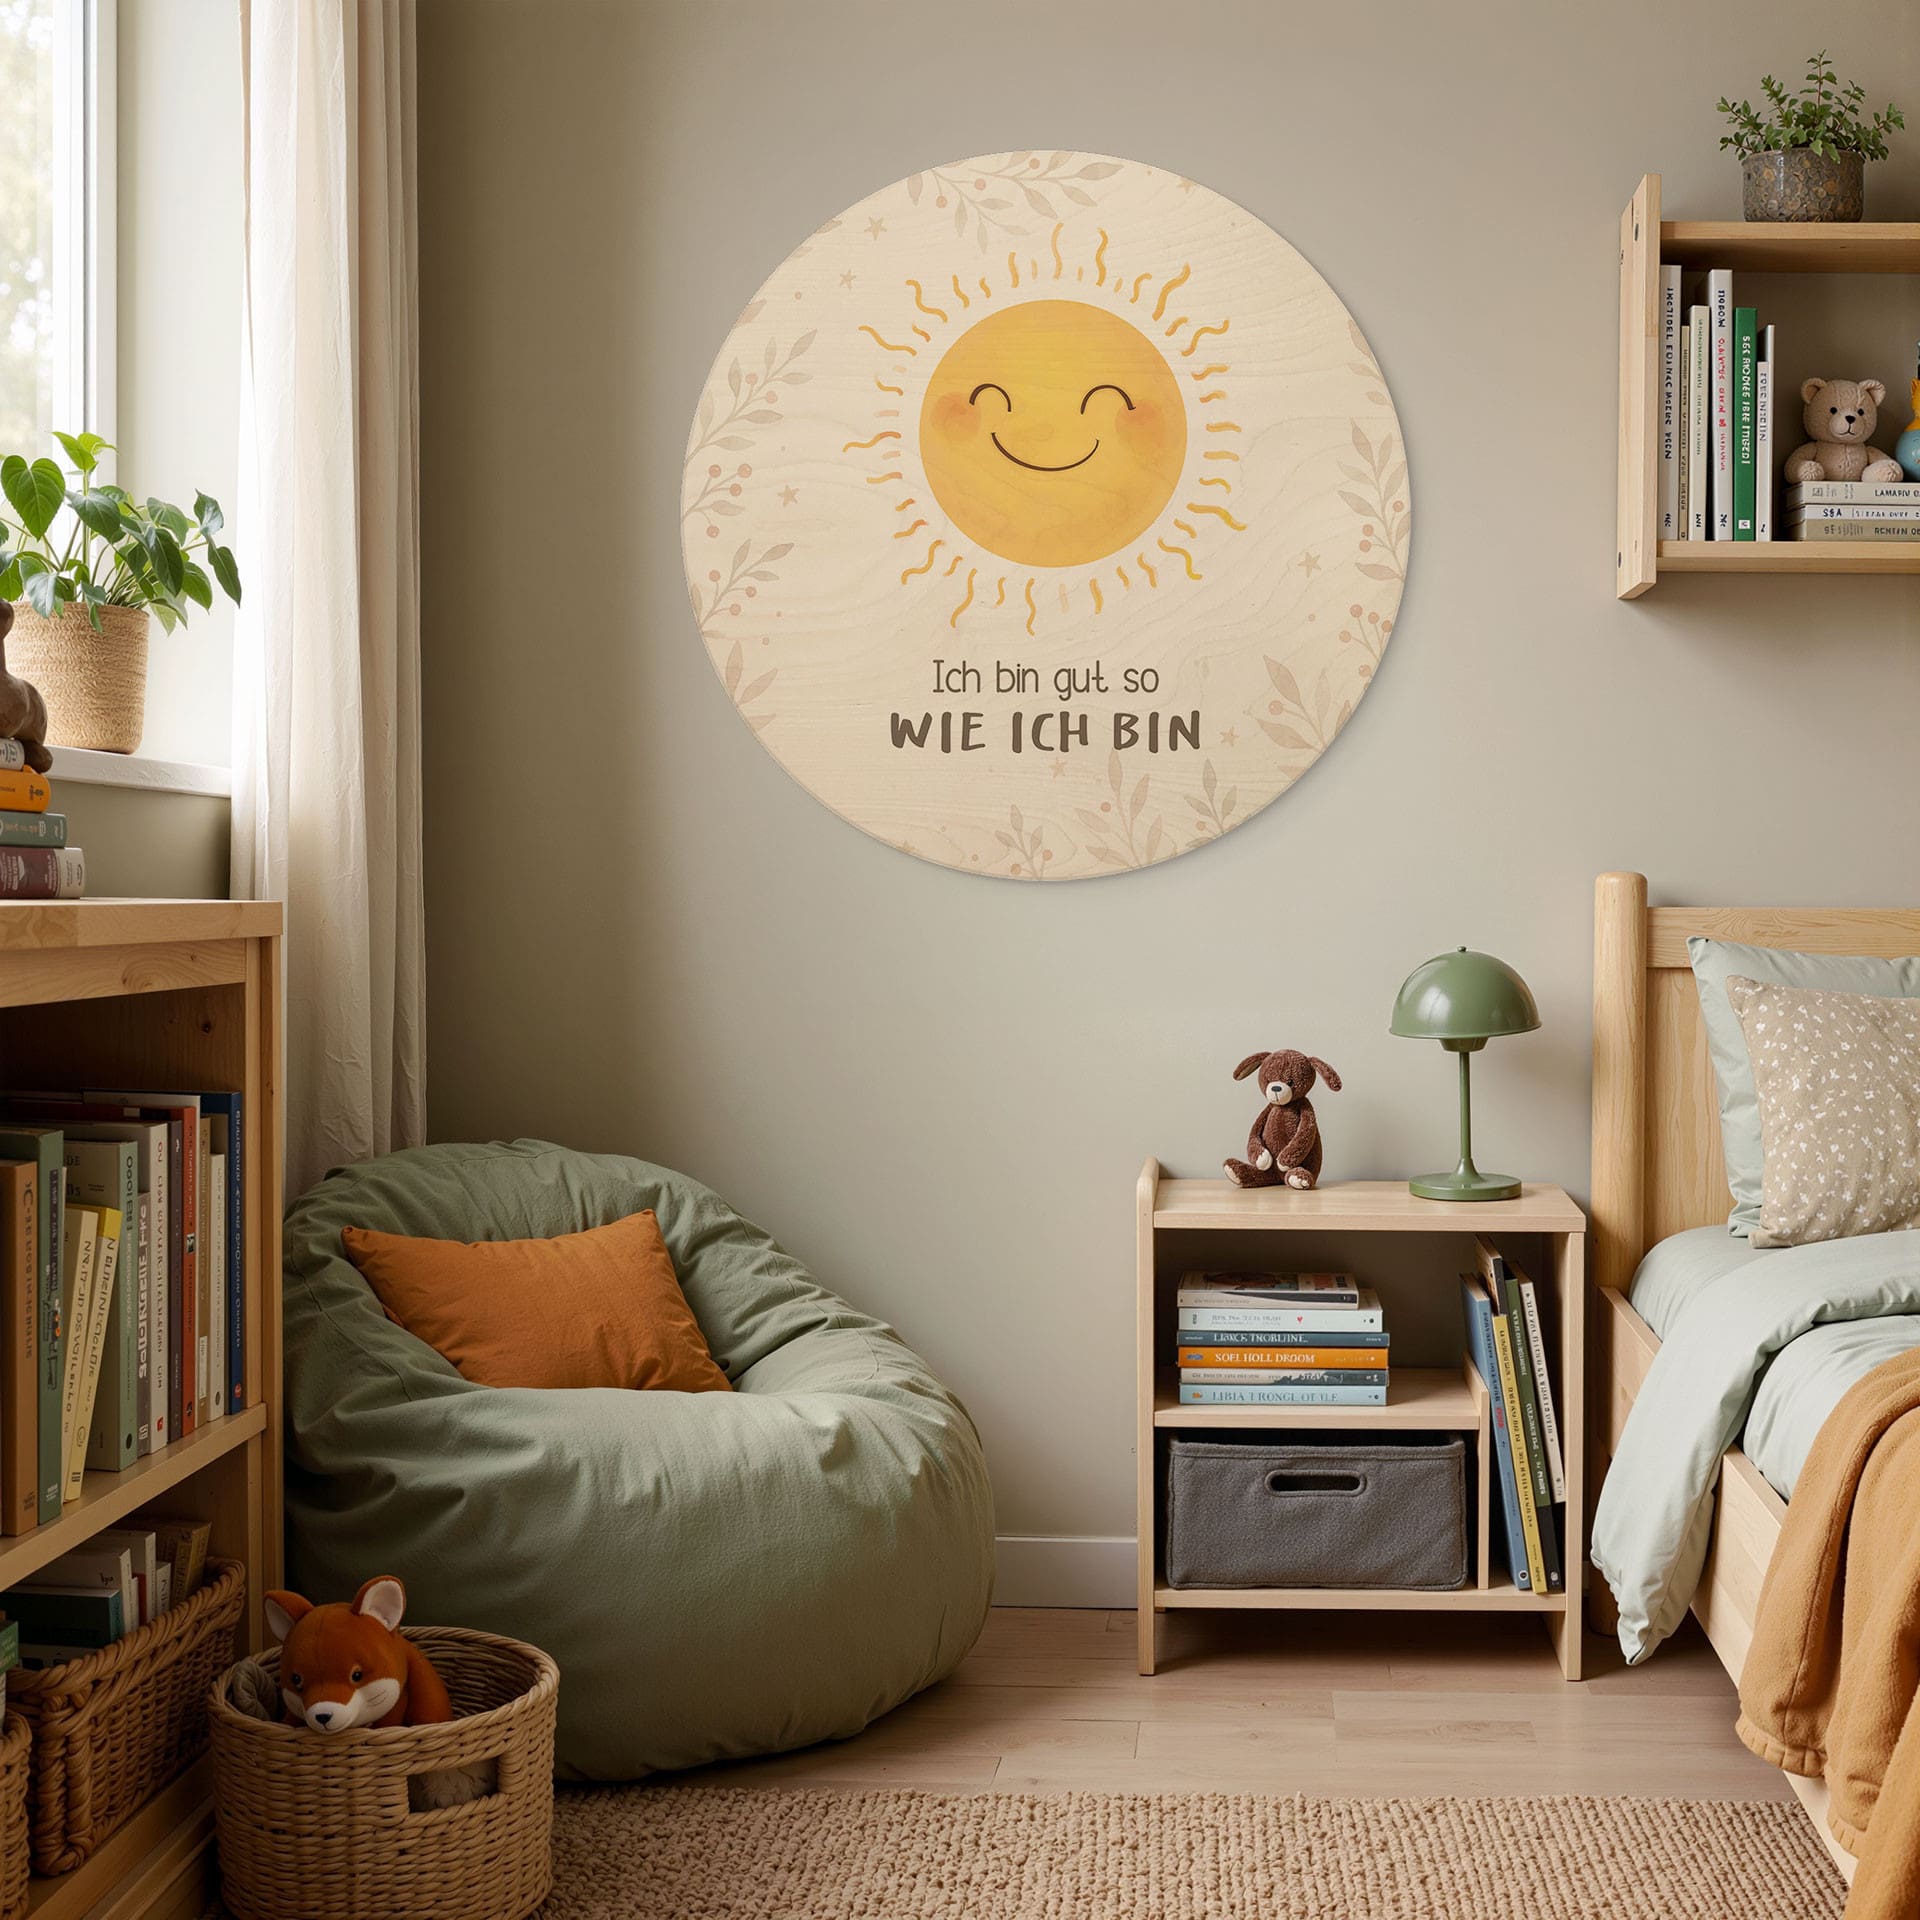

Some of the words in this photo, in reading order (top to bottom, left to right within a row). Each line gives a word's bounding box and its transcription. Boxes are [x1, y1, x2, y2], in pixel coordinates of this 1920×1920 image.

[932, 659, 981, 694] Ich
[996, 659, 1039, 694] bin
[1053, 659, 1109, 702] gut
[1123, 667, 1160, 694] so
[890, 711, 986, 754] WIE
[1012, 711, 1089, 754] ICH
[1113, 709, 1201, 754] BIN
